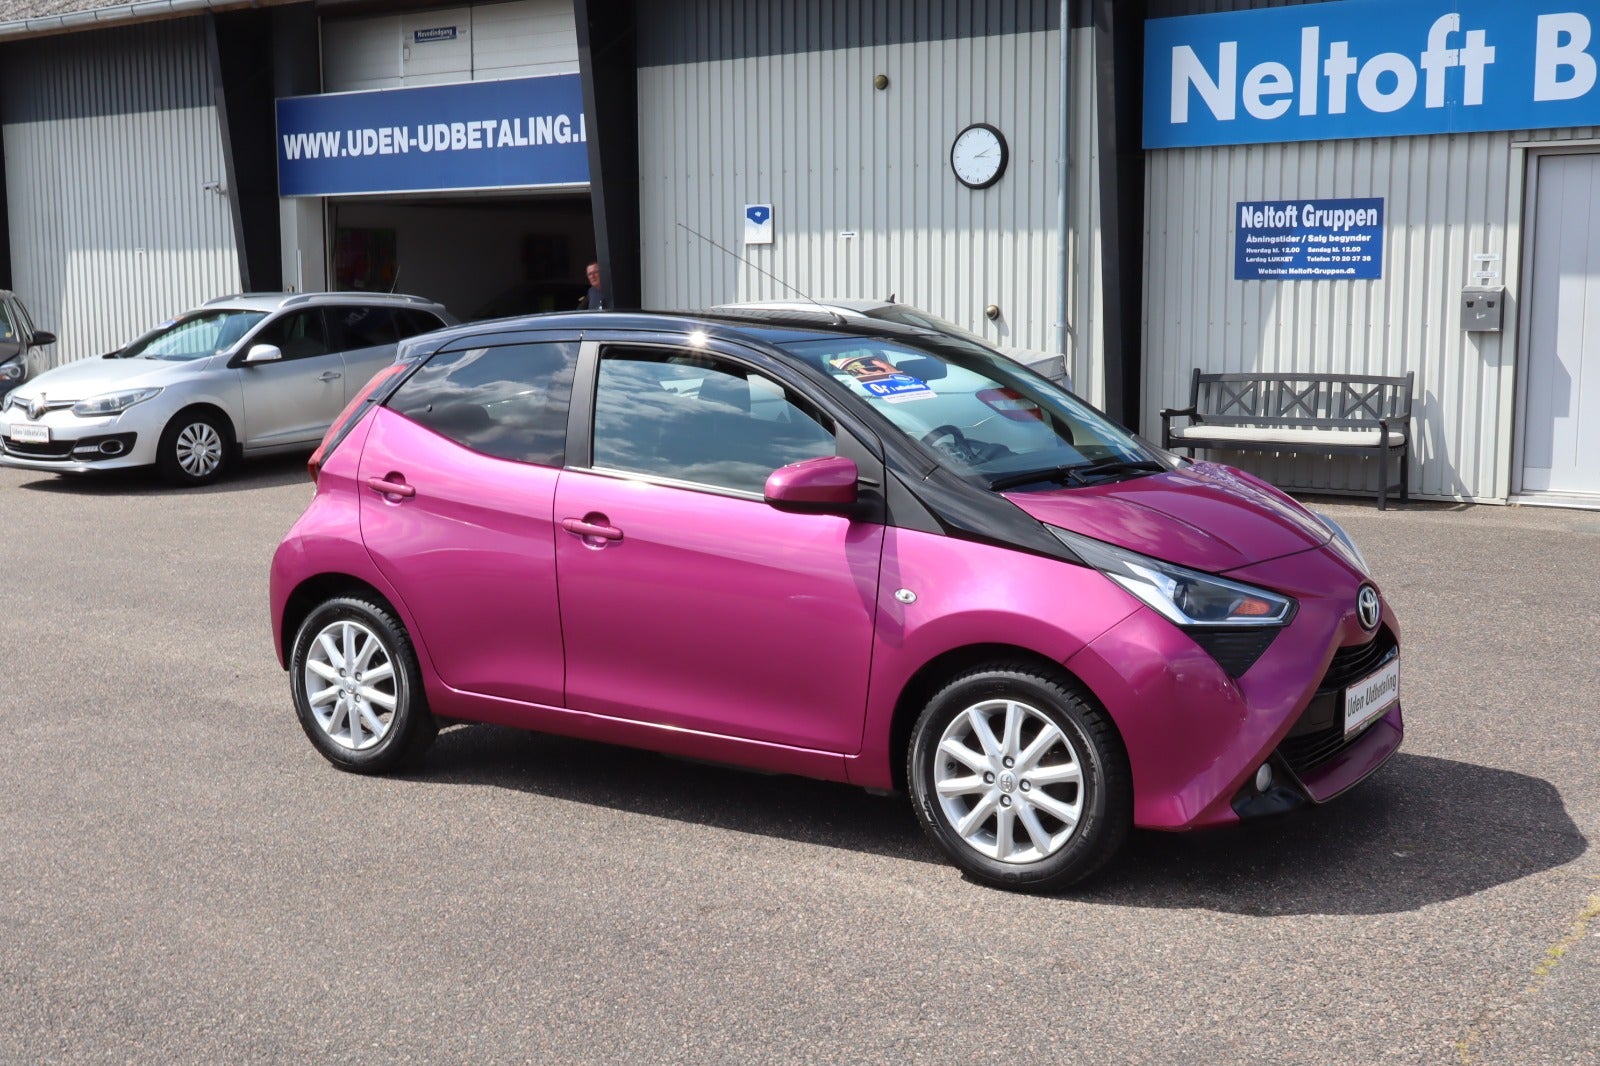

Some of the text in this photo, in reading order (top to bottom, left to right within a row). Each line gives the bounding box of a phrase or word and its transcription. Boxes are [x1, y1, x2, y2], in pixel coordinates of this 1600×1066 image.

[1170, 12, 1598, 124] Neltoft B
[1241, 204, 1378, 231] Neltoft Gruppen
[1246, 234, 1300, 243] Åbningstider
[1307, 234, 1328, 243] Salg
[1328, 234, 1371, 243] begynder
[1288, 267, 1356, 275] Neltoft-Gruppen.dk
[1347, 673, 1397, 718] Uden Udbetaling
